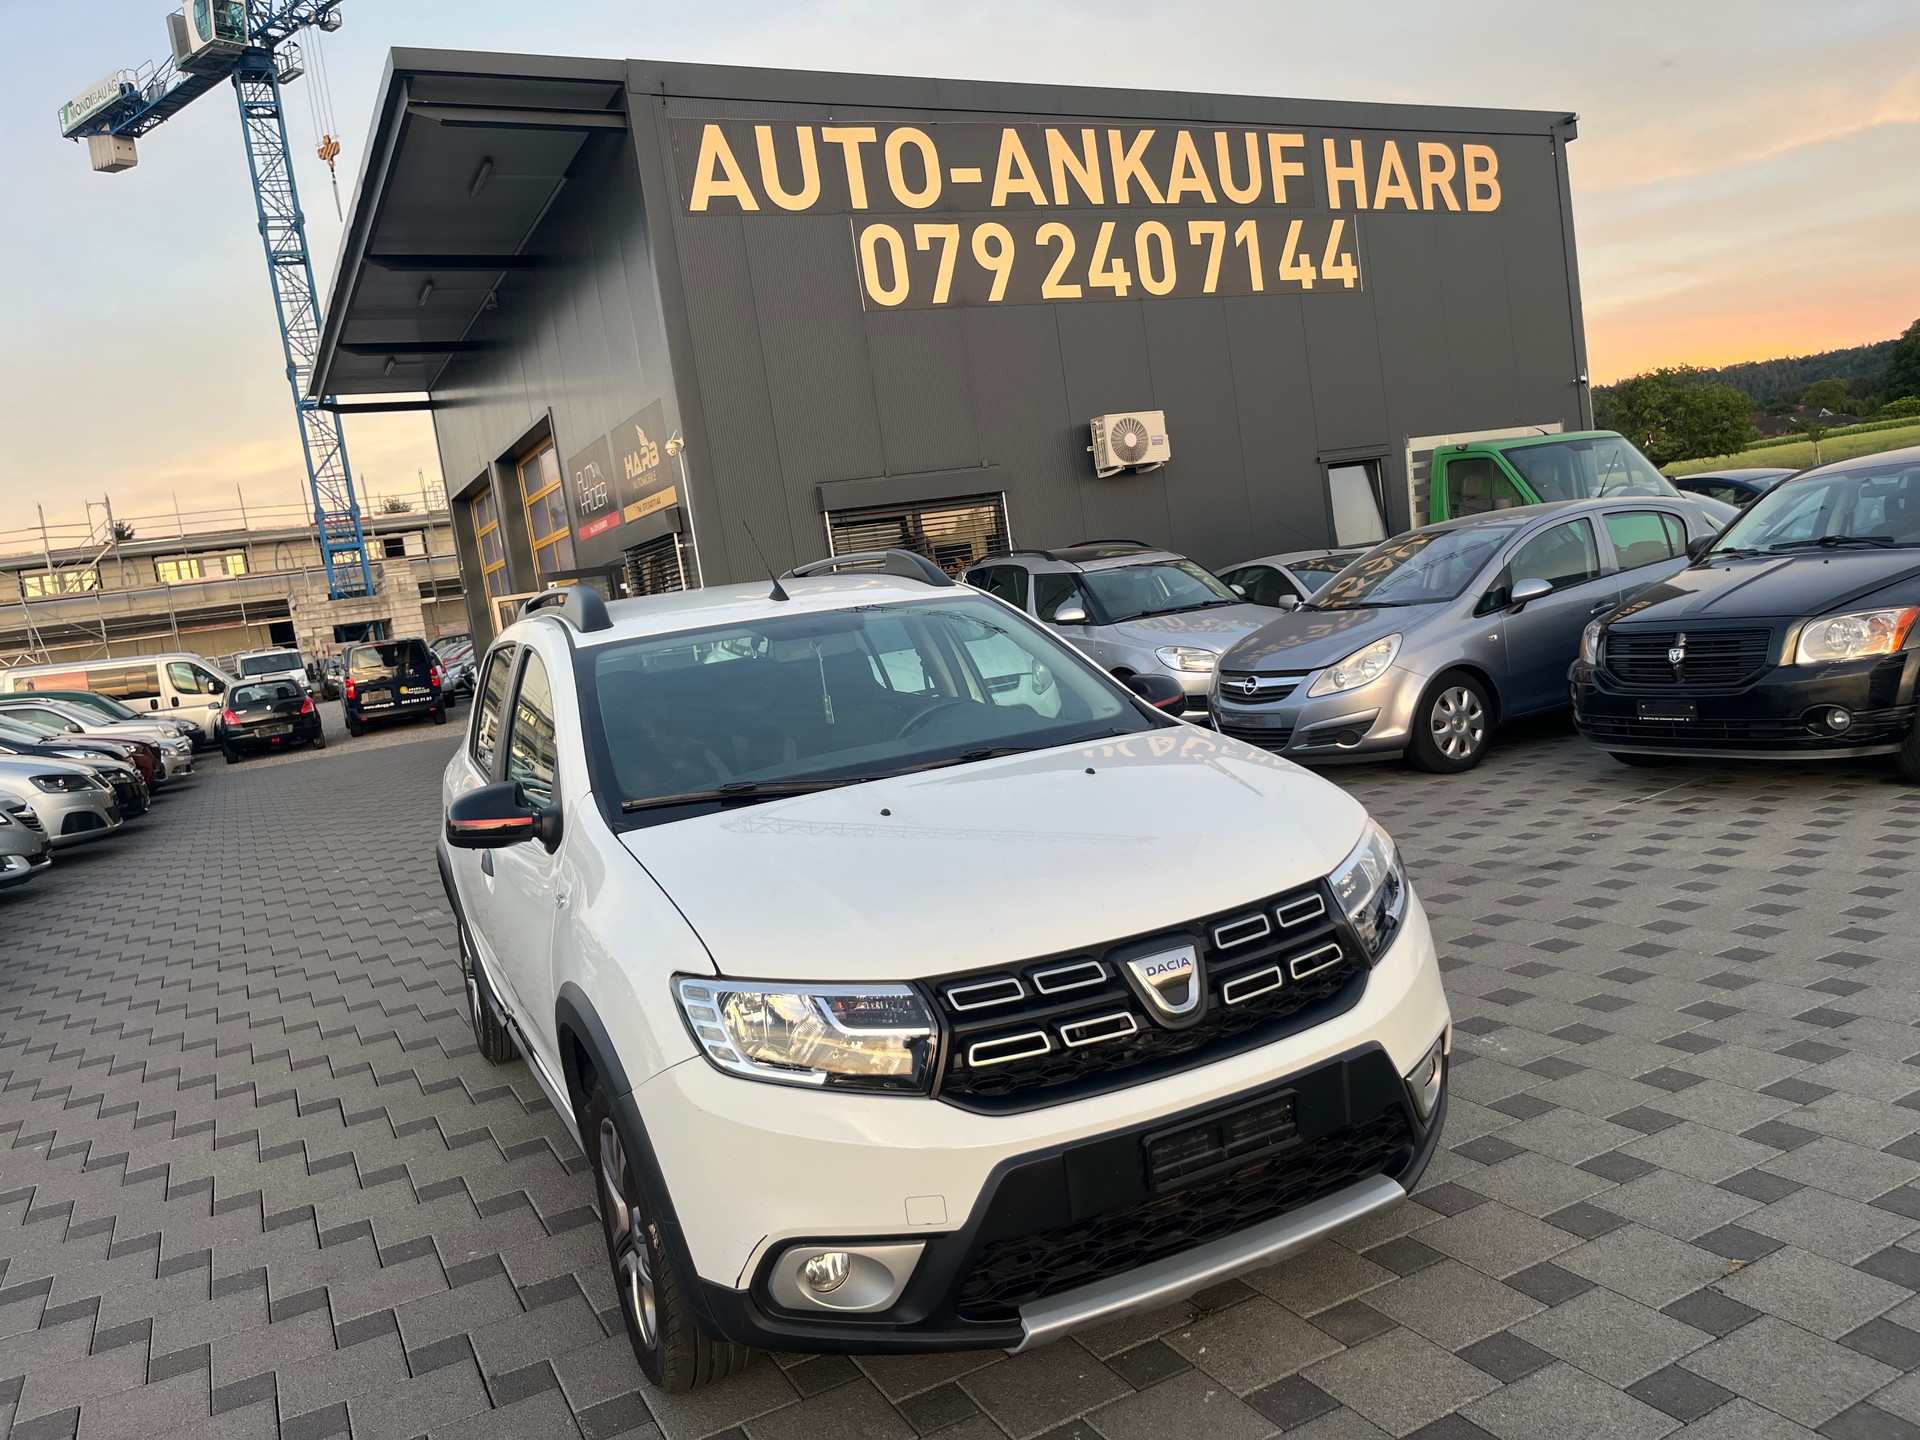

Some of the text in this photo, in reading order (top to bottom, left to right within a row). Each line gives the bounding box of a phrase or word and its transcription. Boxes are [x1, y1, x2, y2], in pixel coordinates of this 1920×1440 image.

[70, 79, 118, 120] MONDIBAU AG
[689, 124, 1502, 213] AUTO-ANKAUF HARB
[860, 222, 1015, 306] 079
[1035, 221, 1177, 299] 240
[623, 440, 660, 479] HARB
[1145, 957, 1191, 976] DACIA
